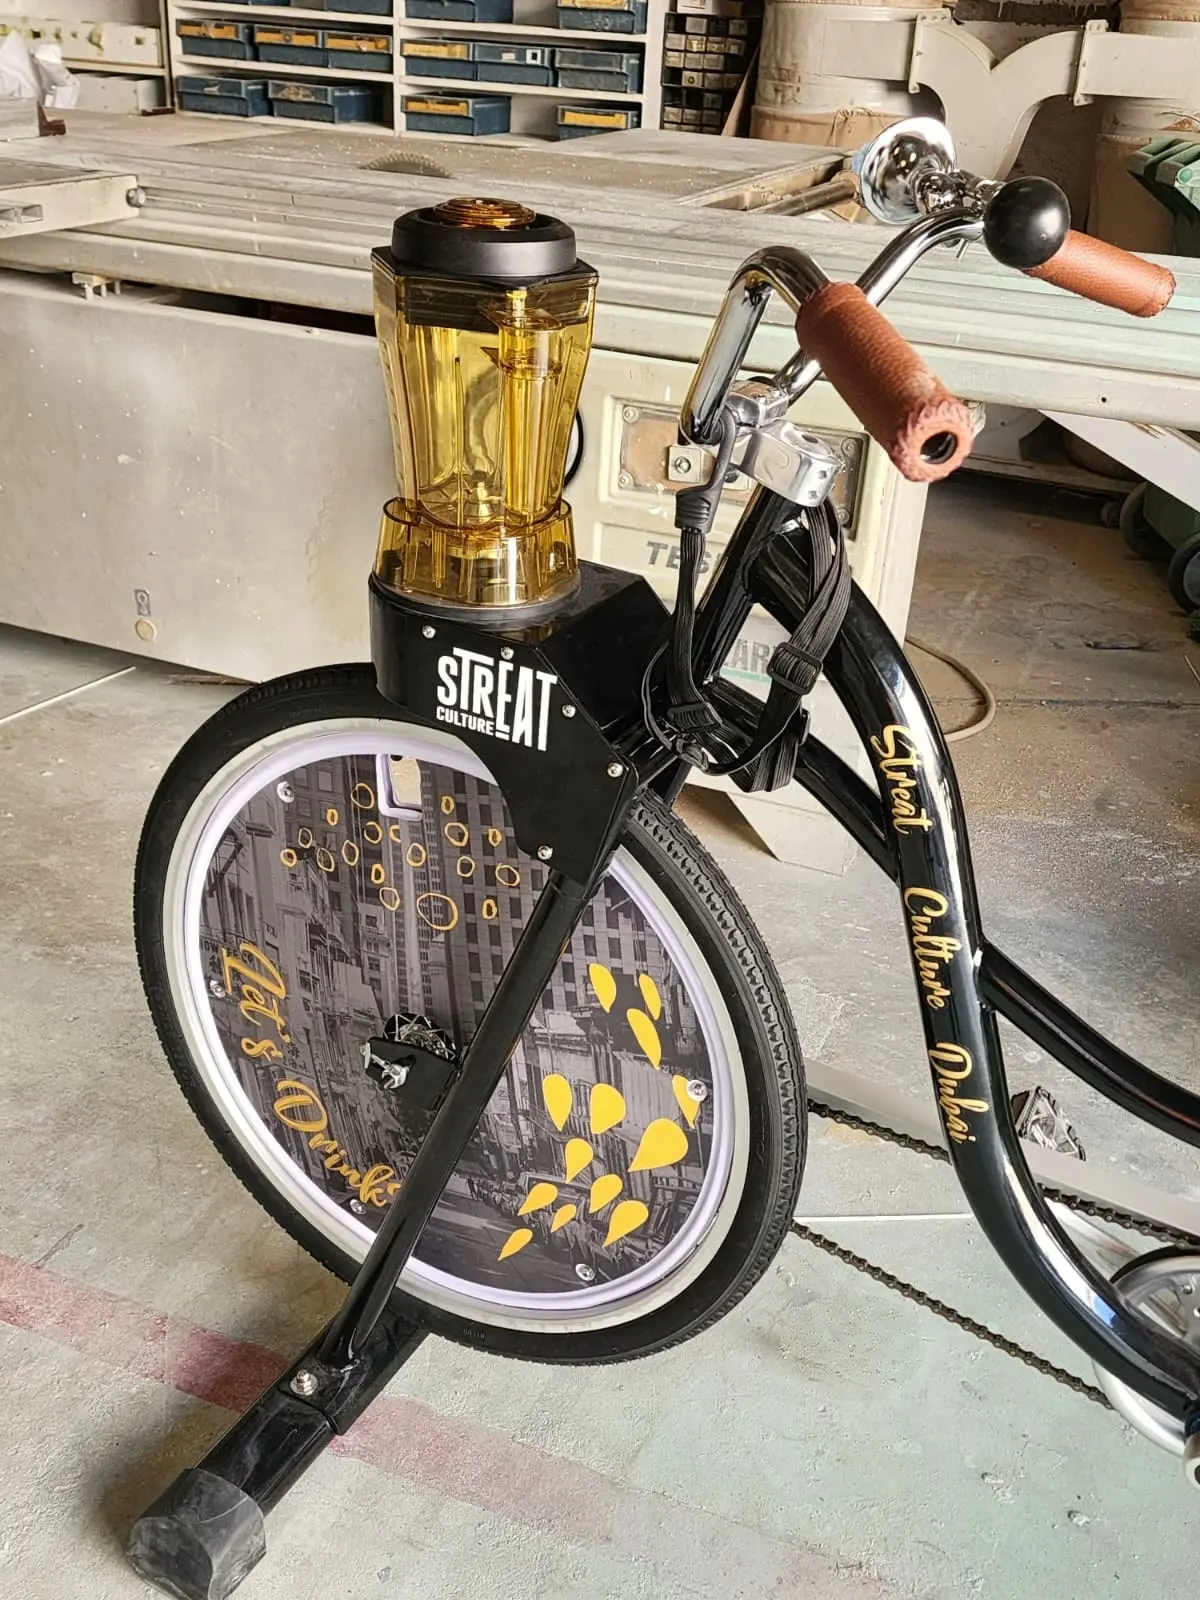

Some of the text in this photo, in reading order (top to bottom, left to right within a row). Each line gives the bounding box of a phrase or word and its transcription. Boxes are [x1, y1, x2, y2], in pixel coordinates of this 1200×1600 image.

[436, 646, 558, 752] STREAT
[436, 706, 495, 736] CULTURE
[870, 723, 990, 1145] Streat Culture Dubai
[219, 941, 293, 1063] Let's
